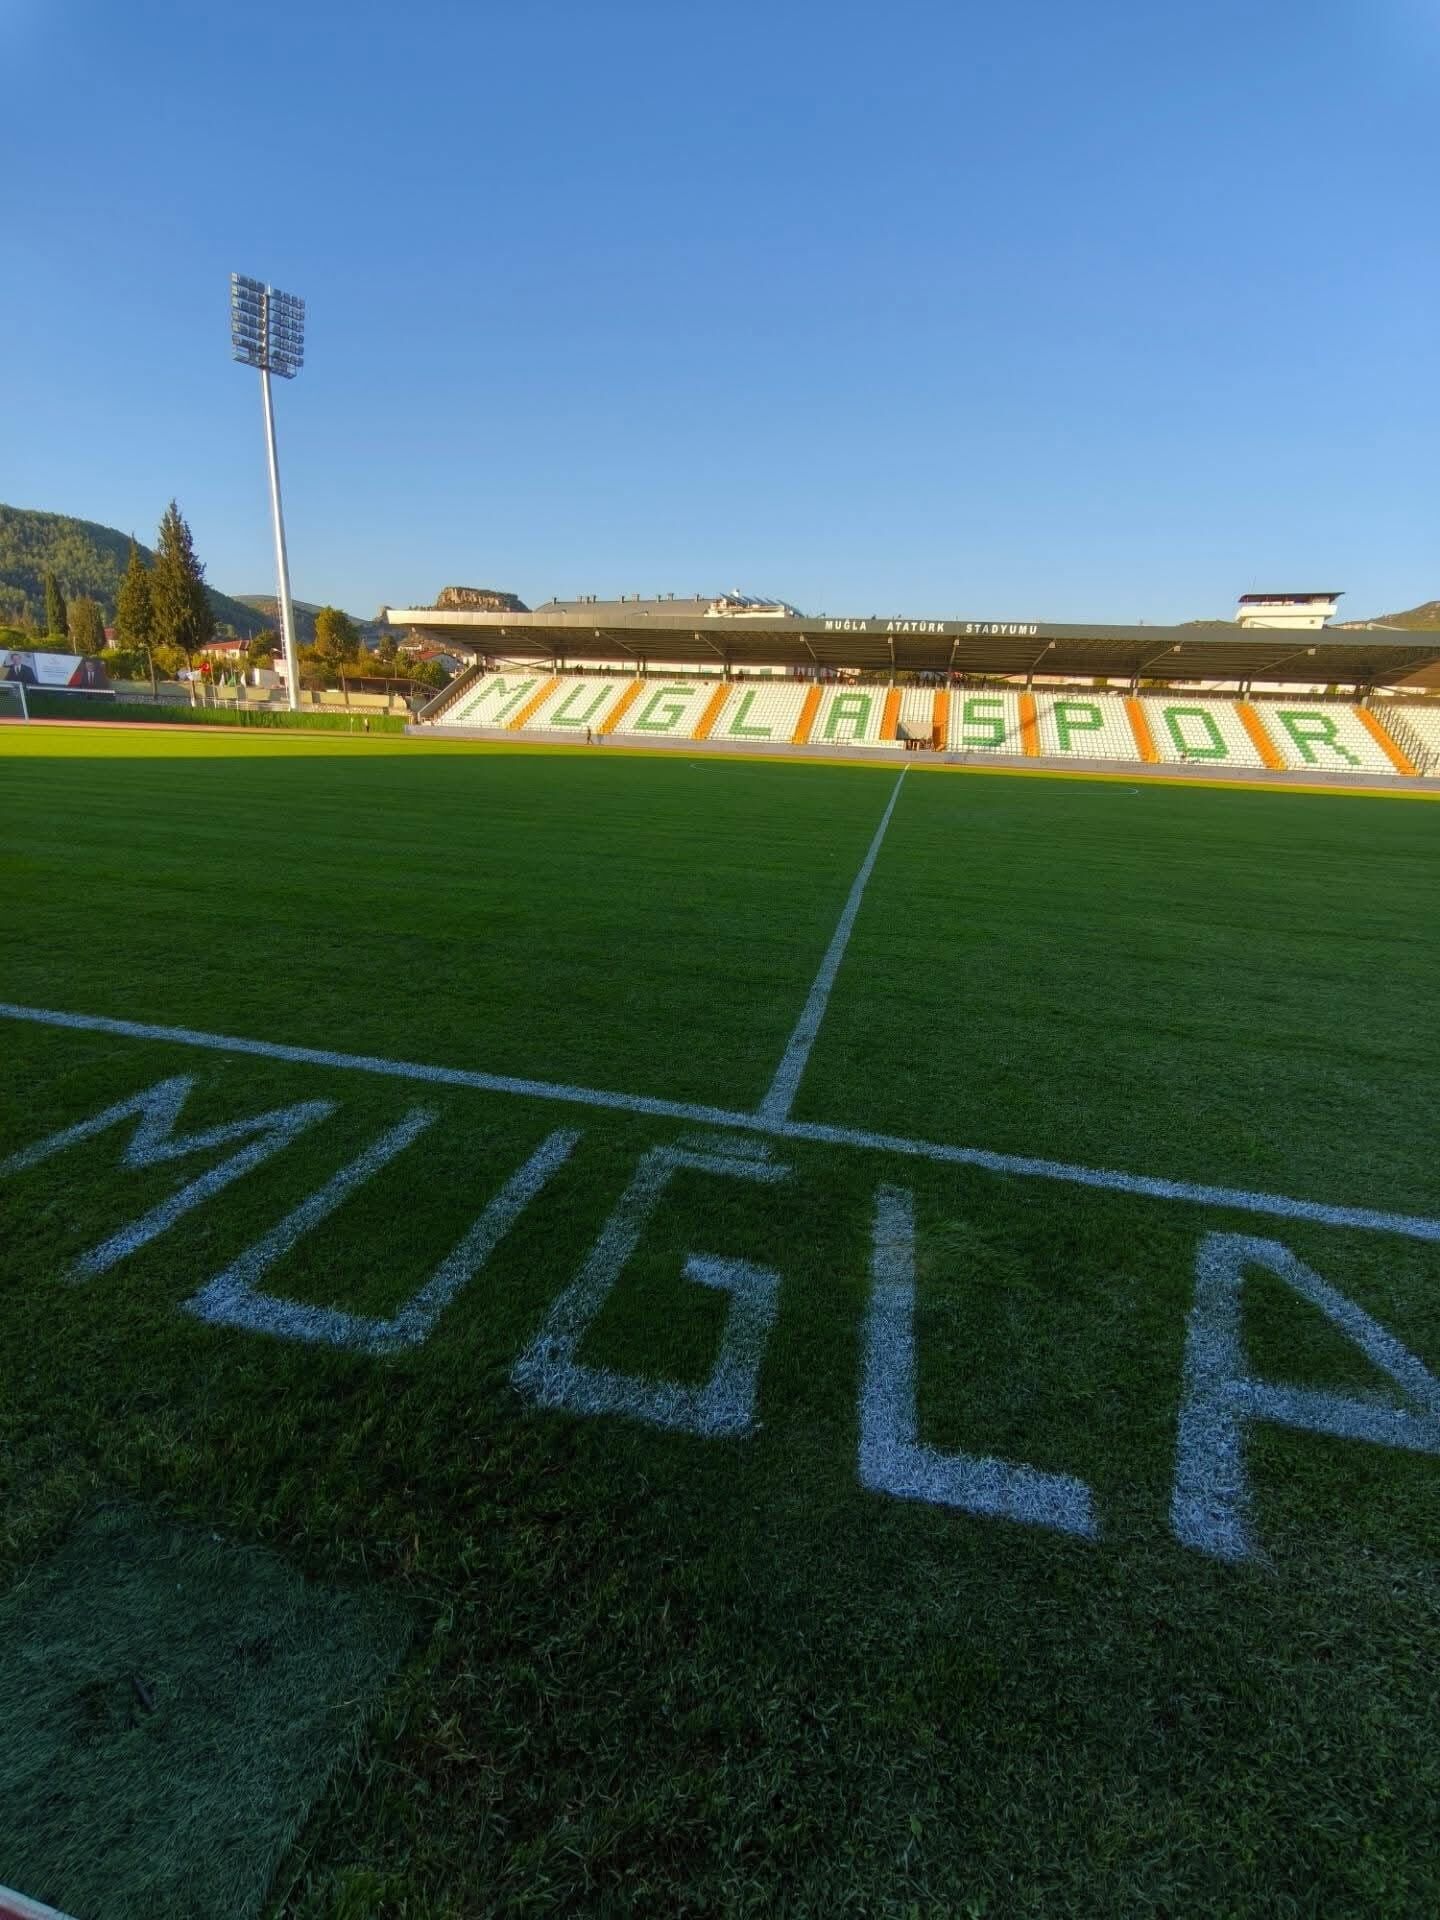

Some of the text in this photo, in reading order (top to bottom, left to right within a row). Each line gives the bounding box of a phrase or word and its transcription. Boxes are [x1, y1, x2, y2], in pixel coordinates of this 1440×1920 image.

[824, 619, 1038, 635] MUĞLA ATATÜRK STADYUMU
